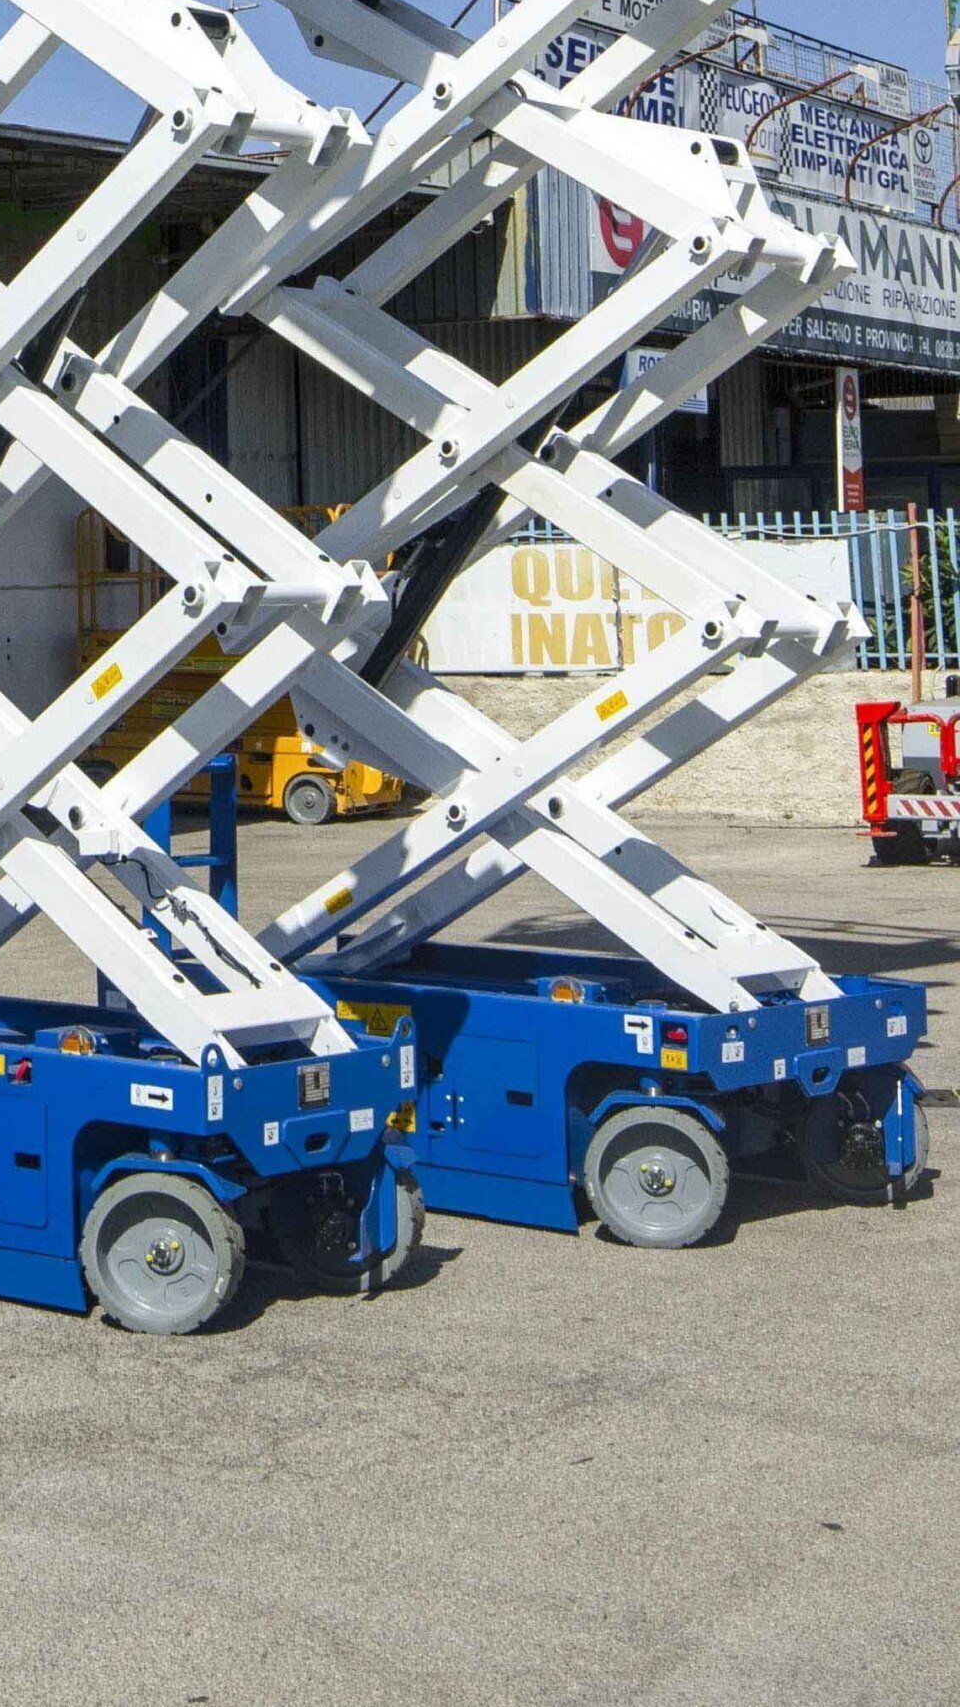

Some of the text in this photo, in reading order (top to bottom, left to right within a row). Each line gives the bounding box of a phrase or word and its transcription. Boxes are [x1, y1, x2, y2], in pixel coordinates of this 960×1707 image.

[720, 81, 776, 121] PEUGEOT
[800, 103, 899, 148] MECCANICA
[791, 123, 909, 171] ELETTRONICA
[794, 148, 909, 194] IMPIANTI GPL
[883, 288, 957, 319] RIPARAZIONE
[806, 318, 851, 344] SALERNO
[855, 325, 862, 345] E
[866, 328, 913, 352] PROVINCIA
